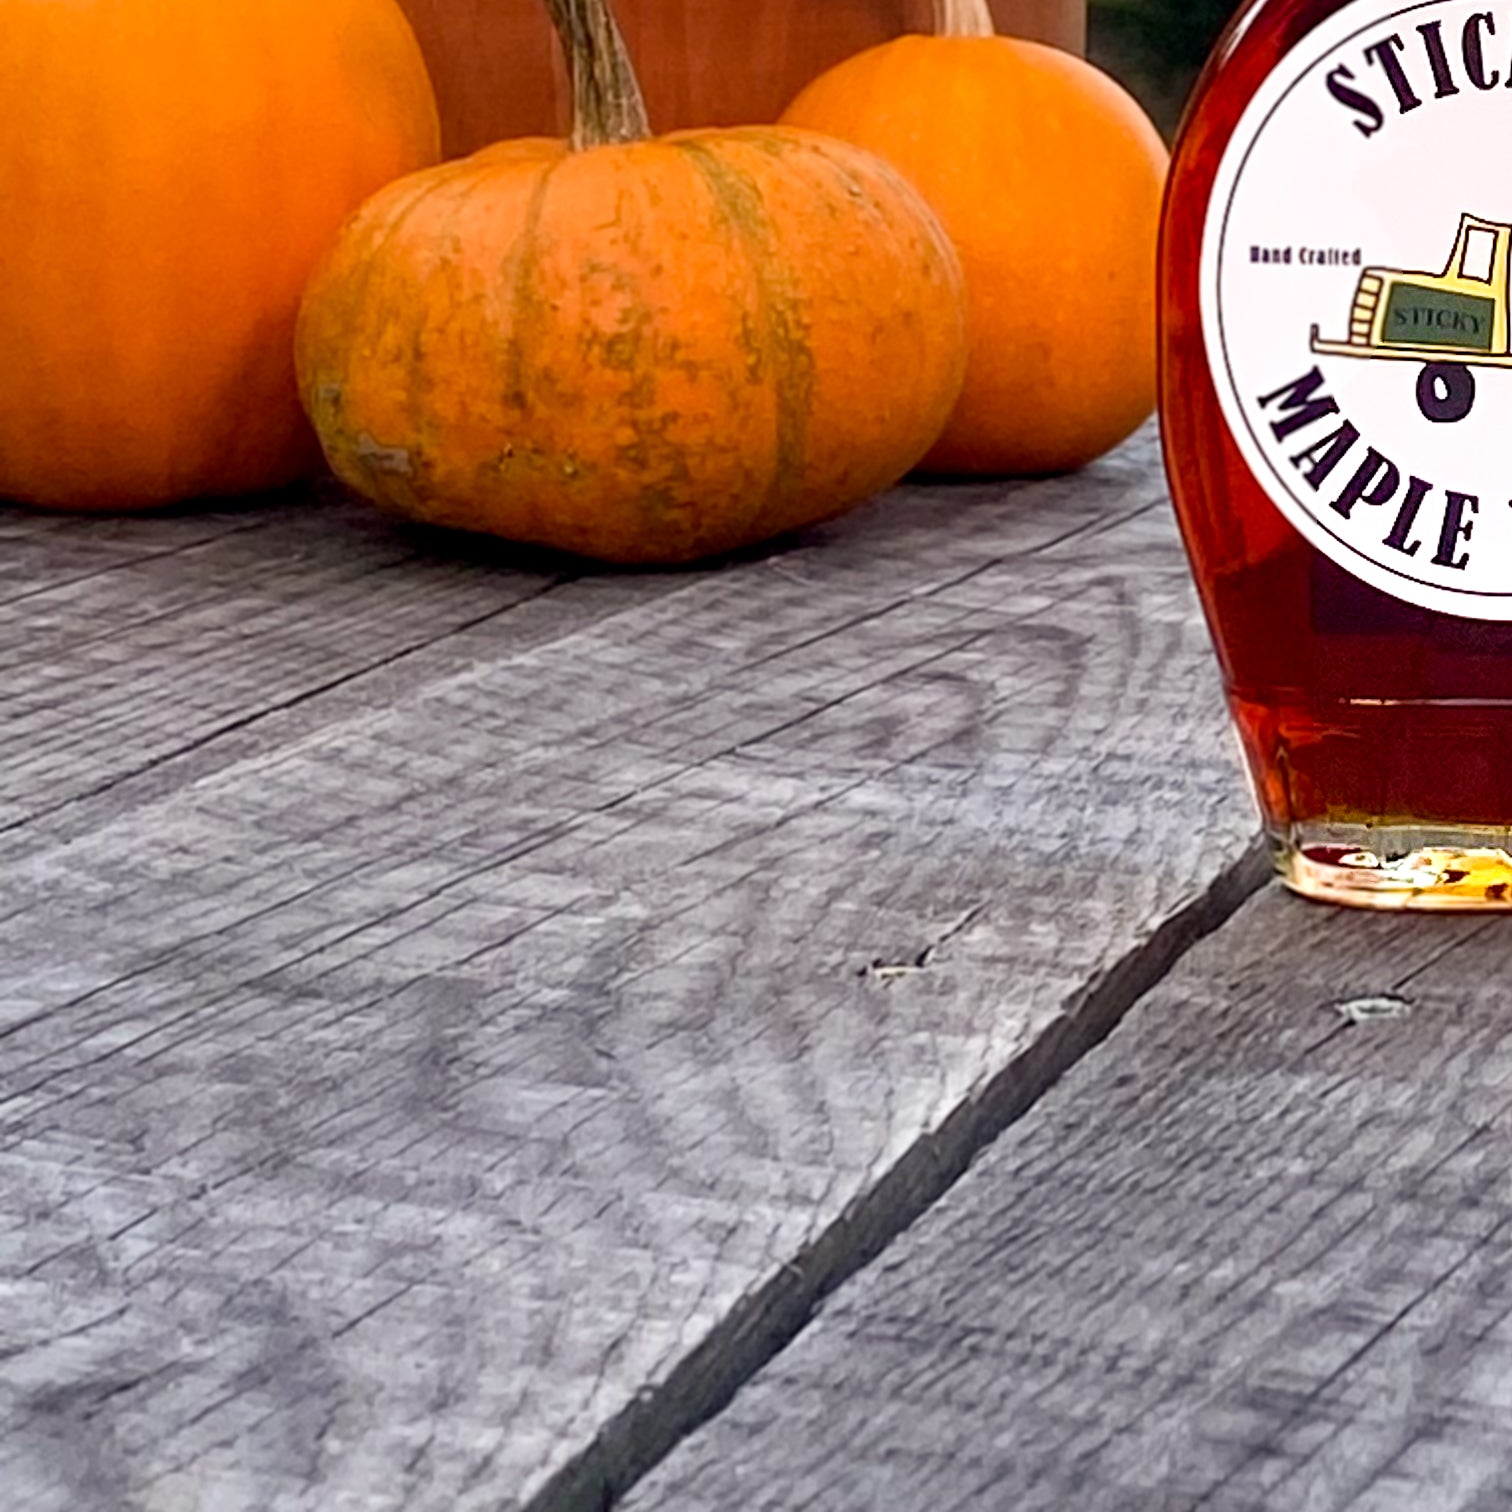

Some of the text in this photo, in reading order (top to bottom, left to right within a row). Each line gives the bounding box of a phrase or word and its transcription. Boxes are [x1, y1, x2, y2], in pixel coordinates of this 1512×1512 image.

[1250, 246, 1362, 266] Hand Crafted
[1394, 307, 1486, 336] STICKY
[1257, 367, 1479, 570] MAPLE
